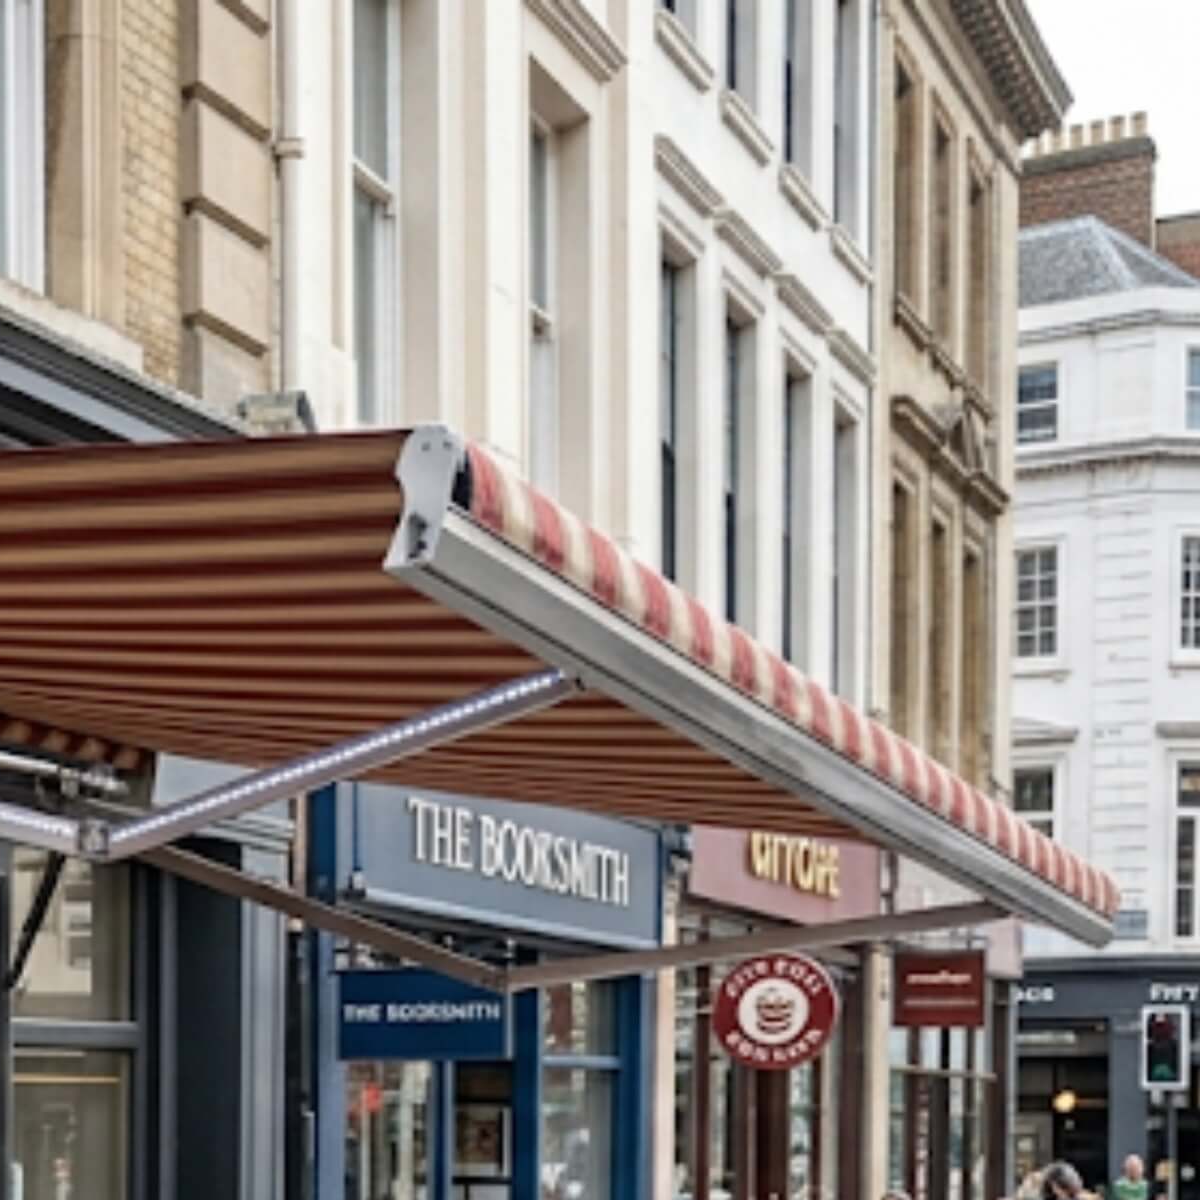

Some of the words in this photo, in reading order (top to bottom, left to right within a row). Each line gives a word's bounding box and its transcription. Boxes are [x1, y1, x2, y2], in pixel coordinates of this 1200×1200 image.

[407, 796, 474, 870] THE
[479, 814, 630, 906] BOOKSMITH
[343, 1003, 381, 1023] THE
